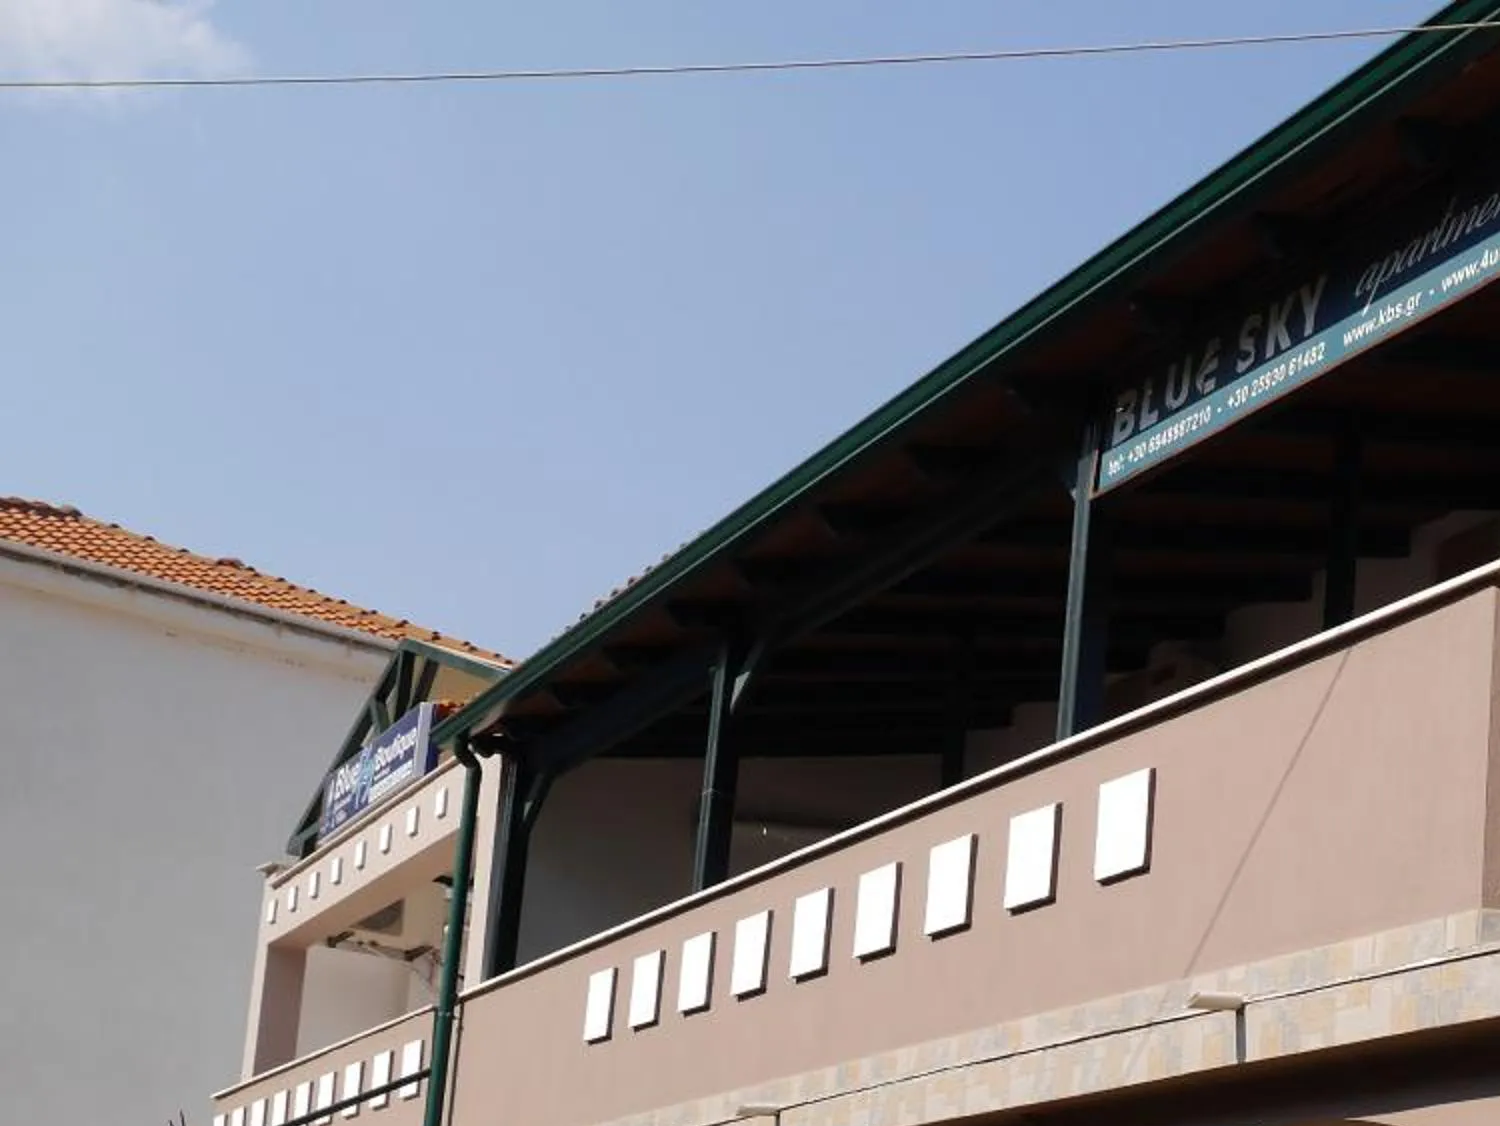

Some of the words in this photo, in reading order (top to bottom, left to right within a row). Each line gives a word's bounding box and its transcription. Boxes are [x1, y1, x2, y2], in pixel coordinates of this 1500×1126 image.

[1110, 336, 1220, 447] BLUE
[1235, 274, 1327, 374] SKY
[1228, 385, 1249, 408] +30
[1288, 341, 1326, 376] 61482
[1343, 291, 1423, 347] www.kbs.gr
